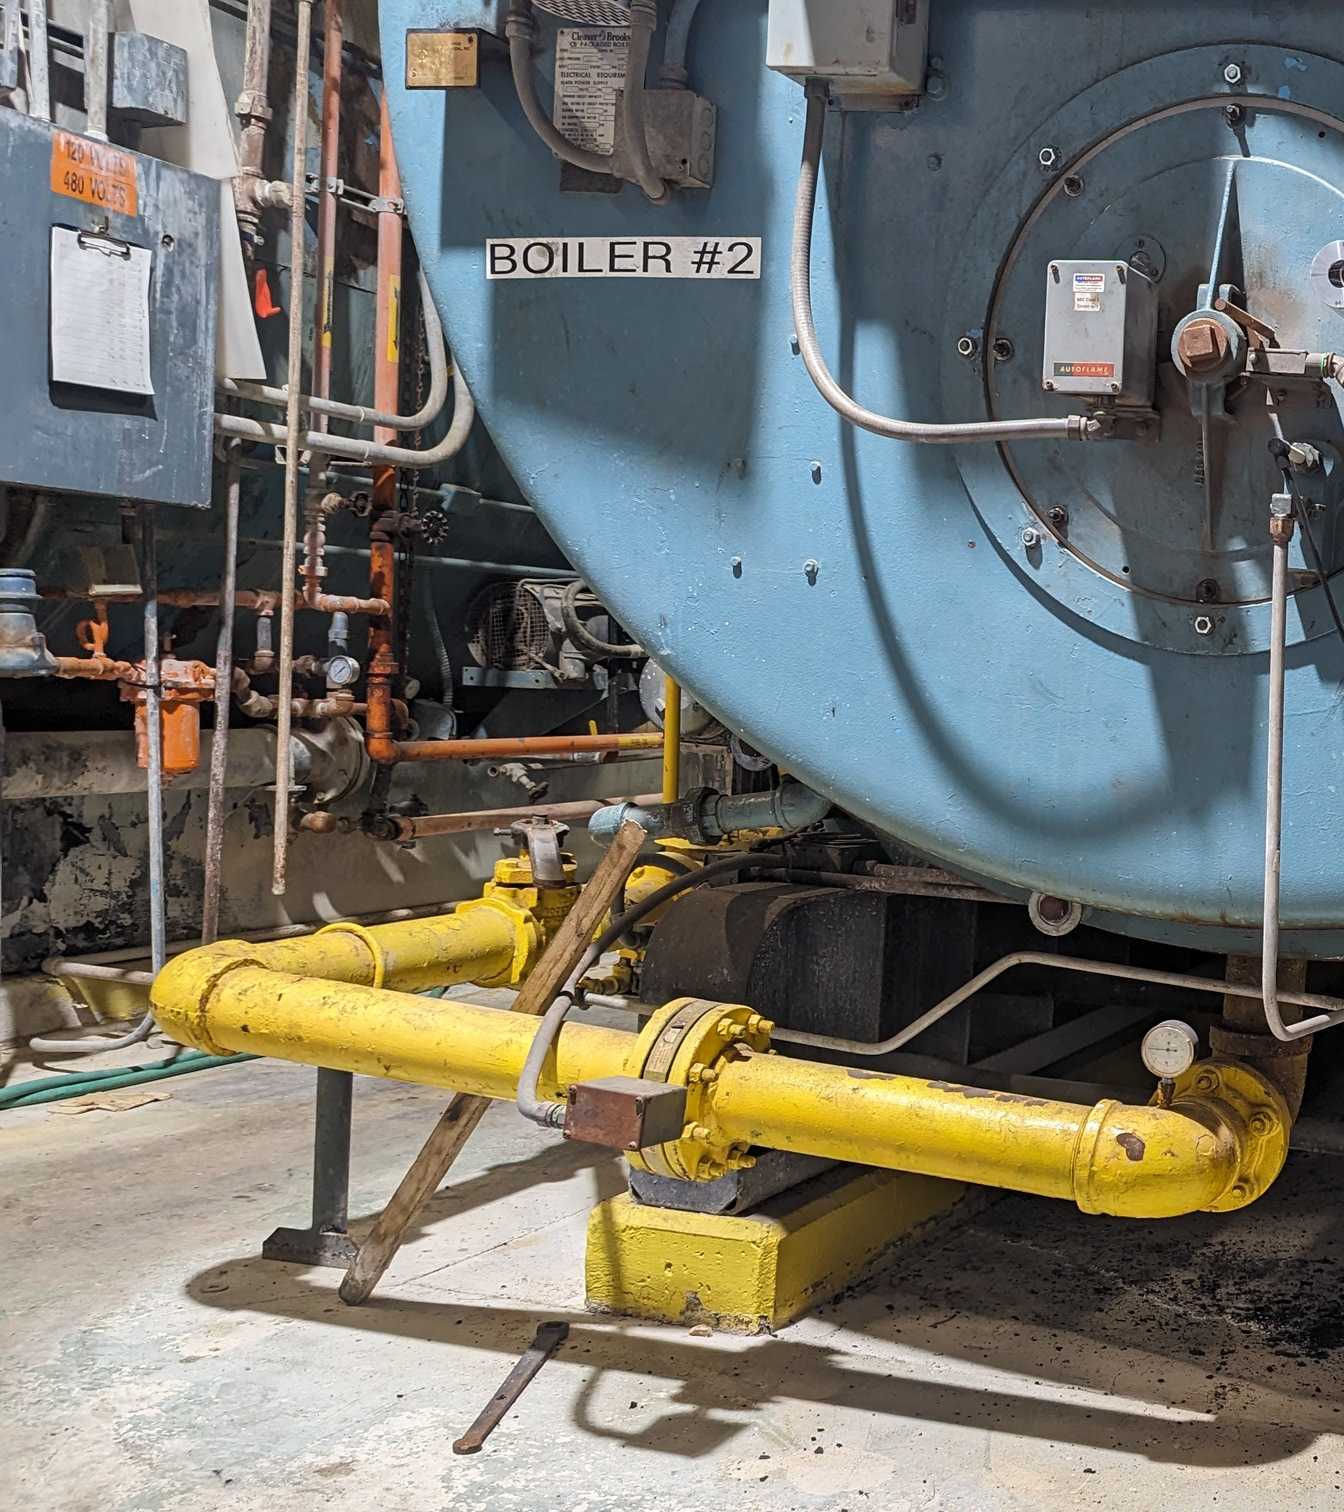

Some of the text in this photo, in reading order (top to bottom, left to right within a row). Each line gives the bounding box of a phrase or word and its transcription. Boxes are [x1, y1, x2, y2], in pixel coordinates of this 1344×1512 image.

[64, 170, 84, 194] 480
[489, 241, 755, 275] BOILER #2
[1060, 365, 1110, 374] AUTOFLAME
